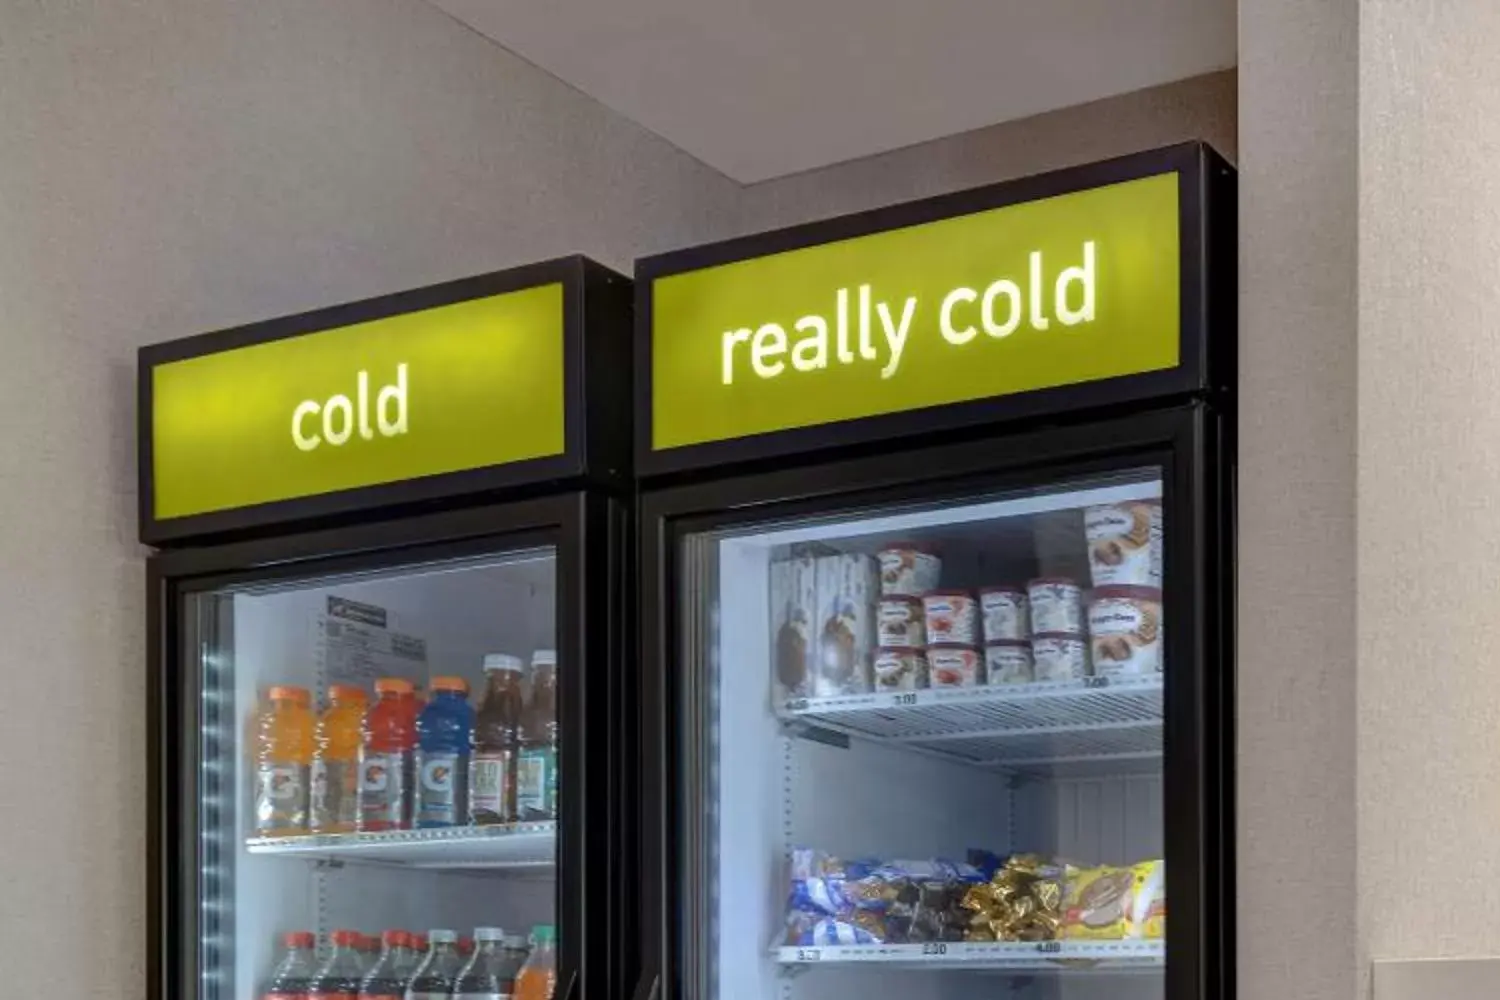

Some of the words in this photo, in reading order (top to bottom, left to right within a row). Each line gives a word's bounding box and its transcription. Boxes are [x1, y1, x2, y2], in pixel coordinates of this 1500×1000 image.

[722, 283, 917, 385] really
[939, 240, 1096, 345] cold
[292, 363, 409, 452] cold
